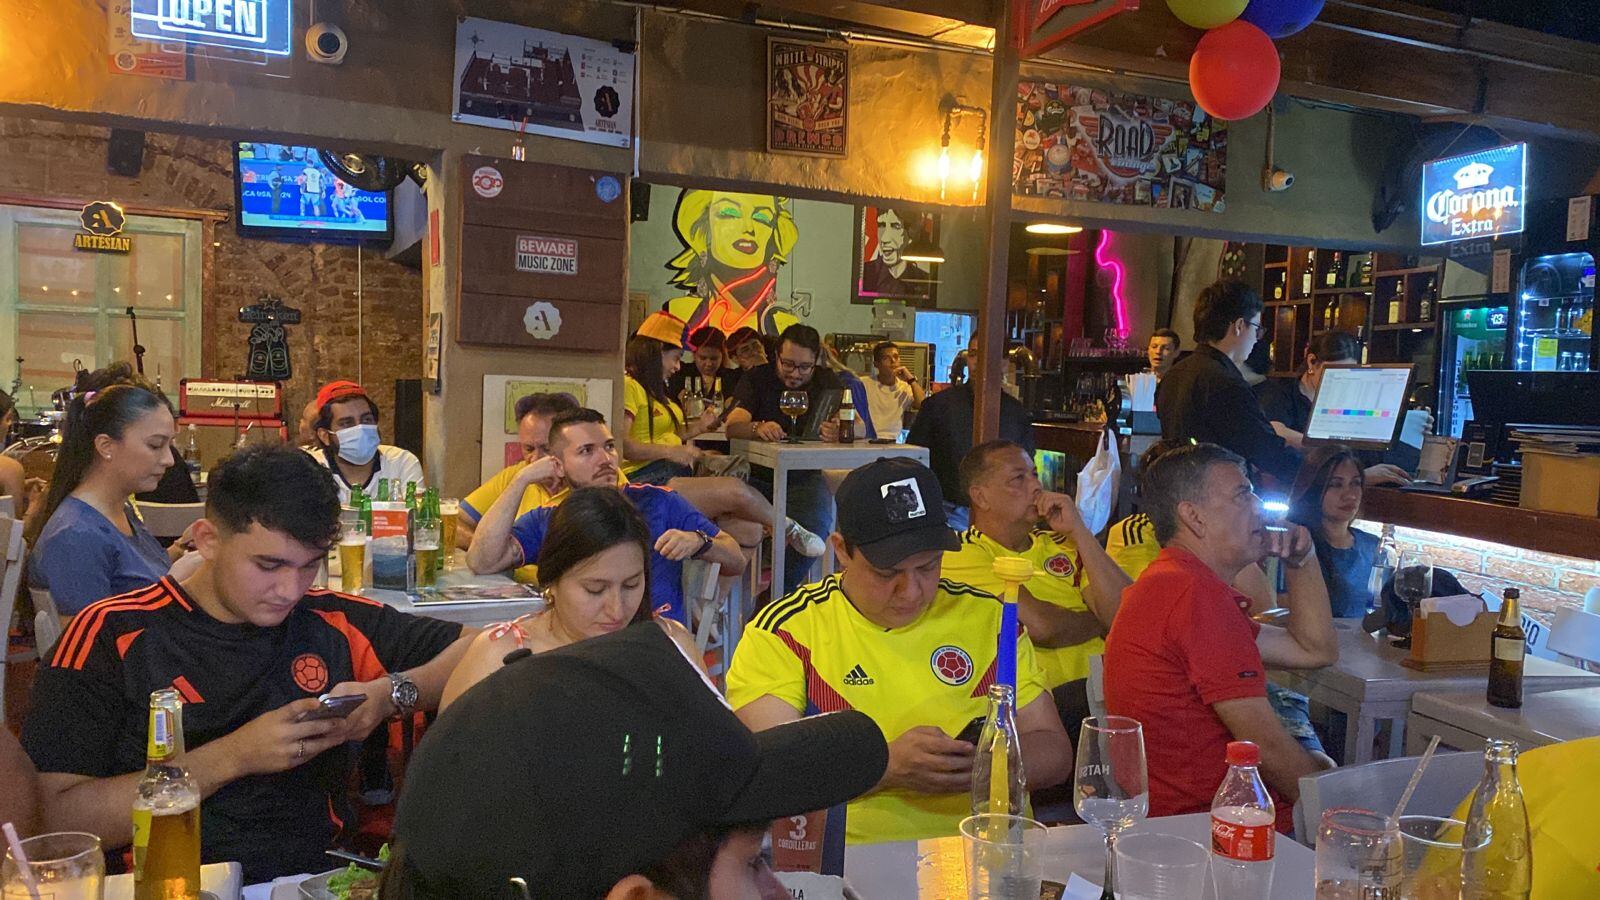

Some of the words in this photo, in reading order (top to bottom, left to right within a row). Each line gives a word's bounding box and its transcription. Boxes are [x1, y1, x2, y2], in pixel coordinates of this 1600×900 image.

[169, 0, 258, 36] OPEN
[775, 50, 804, 65] WHITE
[1097, 114, 1155, 158] ROAD
[1451, 217, 1494, 236] Extra
[74, 234, 130, 251] ARTESIAN
[519, 239, 575, 256] BEWARE
[518, 254, 549, 270] MUSIC
[550, 256, 575, 272] ZONE
[843, 677, 875, 686] adidas
[789, 814, 807, 841] 3
[777, 838, 817, 851] CORDILLERAS
